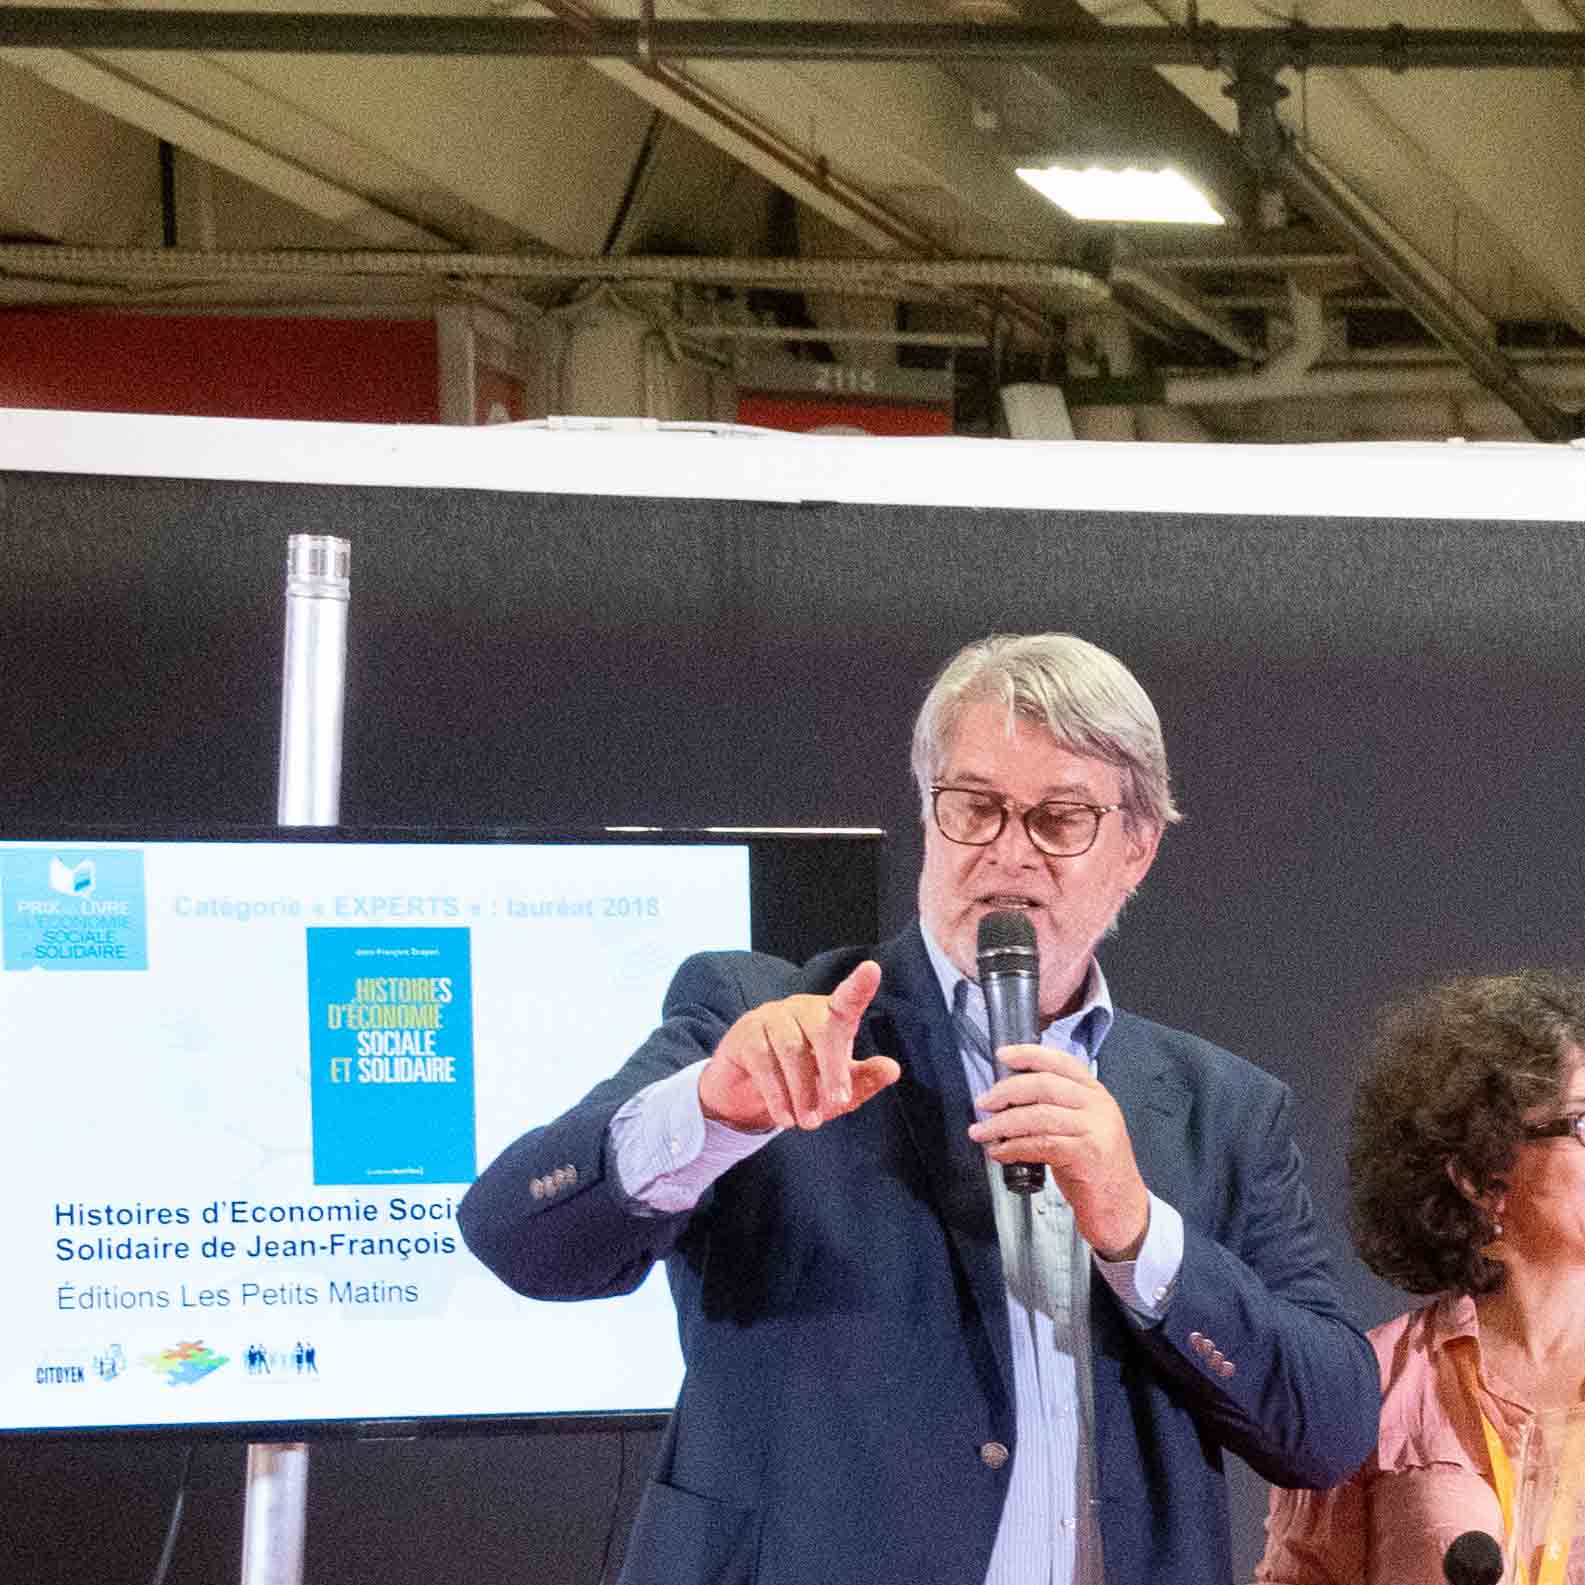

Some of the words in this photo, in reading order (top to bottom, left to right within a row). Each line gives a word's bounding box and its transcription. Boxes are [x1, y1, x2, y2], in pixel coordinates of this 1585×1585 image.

[335, 895, 460, 917] EXPERTS
[602, 895, 659, 918] 2018
[43, 929, 117, 944] SOCIALE
[33, 944, 127, 959] SOLIDAIRE
[355, 977, 453, 1002] HISTOIRES
[328, 998, 444, 1029] D'ÉCONOMIE
[358, 1030, 437, 1056] SOCIALE
[331, 1057, 352, 1082] ET
[358, 1056, 456, 1083] SOLIDAIRE
[56, 1202, 190, 1226] Histoires
[202, 1200, 378, 1224] d'Economie
[389, 1198, 461, 1221] Soci
[56, 1236, 189, 1261] Solidaire
[202, 1236, 236, 1259] de
[247, 1232, 456, 1261] Jean-François
[58, 1281, 170, 1310] Éditions
[181, 1284, 231, 1307] Les
[242, 1282, 318, 1306] Petits
[329, 1280, 418, 1304] Matins
